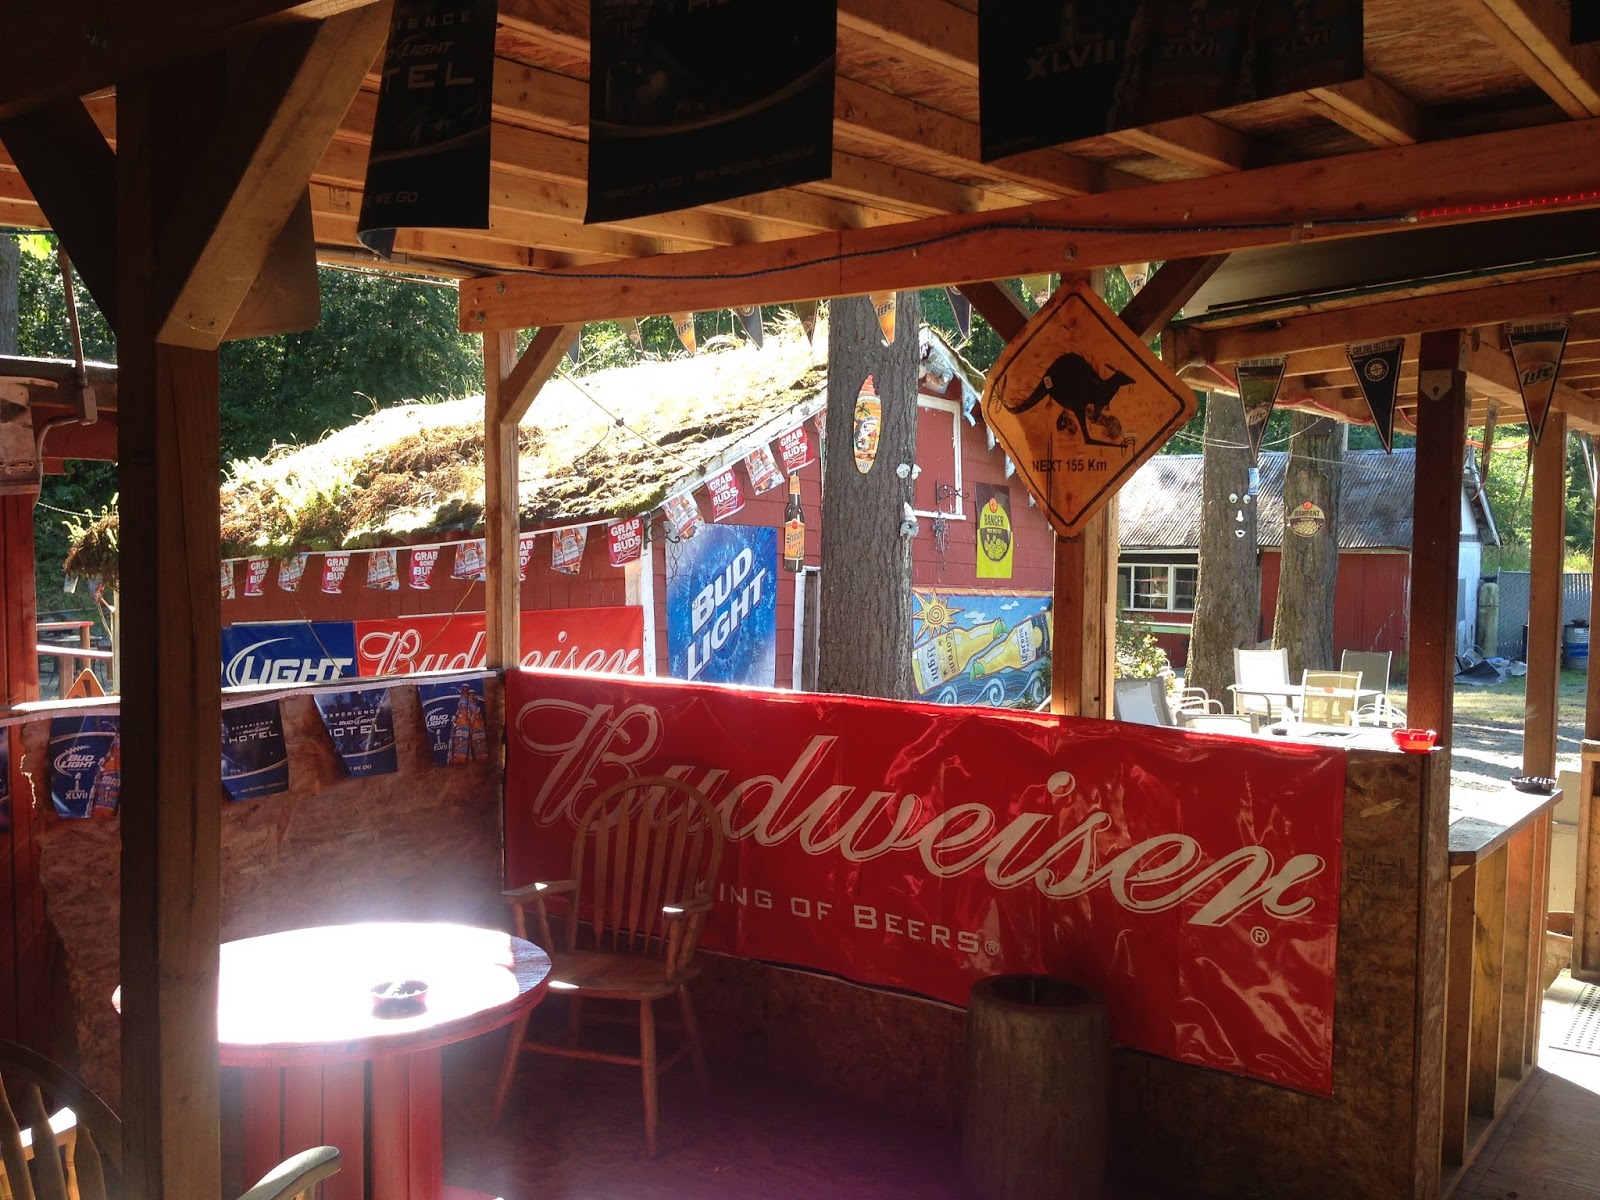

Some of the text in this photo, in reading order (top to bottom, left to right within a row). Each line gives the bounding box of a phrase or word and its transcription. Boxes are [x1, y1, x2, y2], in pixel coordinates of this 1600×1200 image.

[1025, 40, 1116, 80] XLVII
[781, 428, 803, 446] GRAB
[785, 439, 800, 450] SOME
[783, 443, 807, 461] BUDS
[1032, 459, 1107, 472] NEXT 155 Km
[710, 472, 733, 491] GRAB
[715, 483, 730, 495] SOME
[713, 487, 739, 506] BUDS
[984, 514, 1004, 526] RANGER
[611, 519, 640, 536] GRAB
[617, 530, 636, 541] SOME
[520, 540, 534, 550] AB
[613, 535, 641, 552] BUDS
[327, 558, 349, 567] GRAB
[415, 551, 438, 561] GRAB
[692, 547, 752, 635] BUD
[687, 568, 766, 681] LIGHT
[241, 657, 354, 687] LIGHT
[323, 709, 381, 719] EXPERIENCE
[427, 719, 450, 727] LIGHT
[228, 731, 279, 744] HOTEL
[60, 760, 96, 768] LIGHT
[67, 754, 95, 762] BUD
[65, 792, 88, 800] XLVII
[515, 698, 1326, 927] Budweiser
[697, 877, 773, 909] ING
[790, 896, 833, 920] OF
